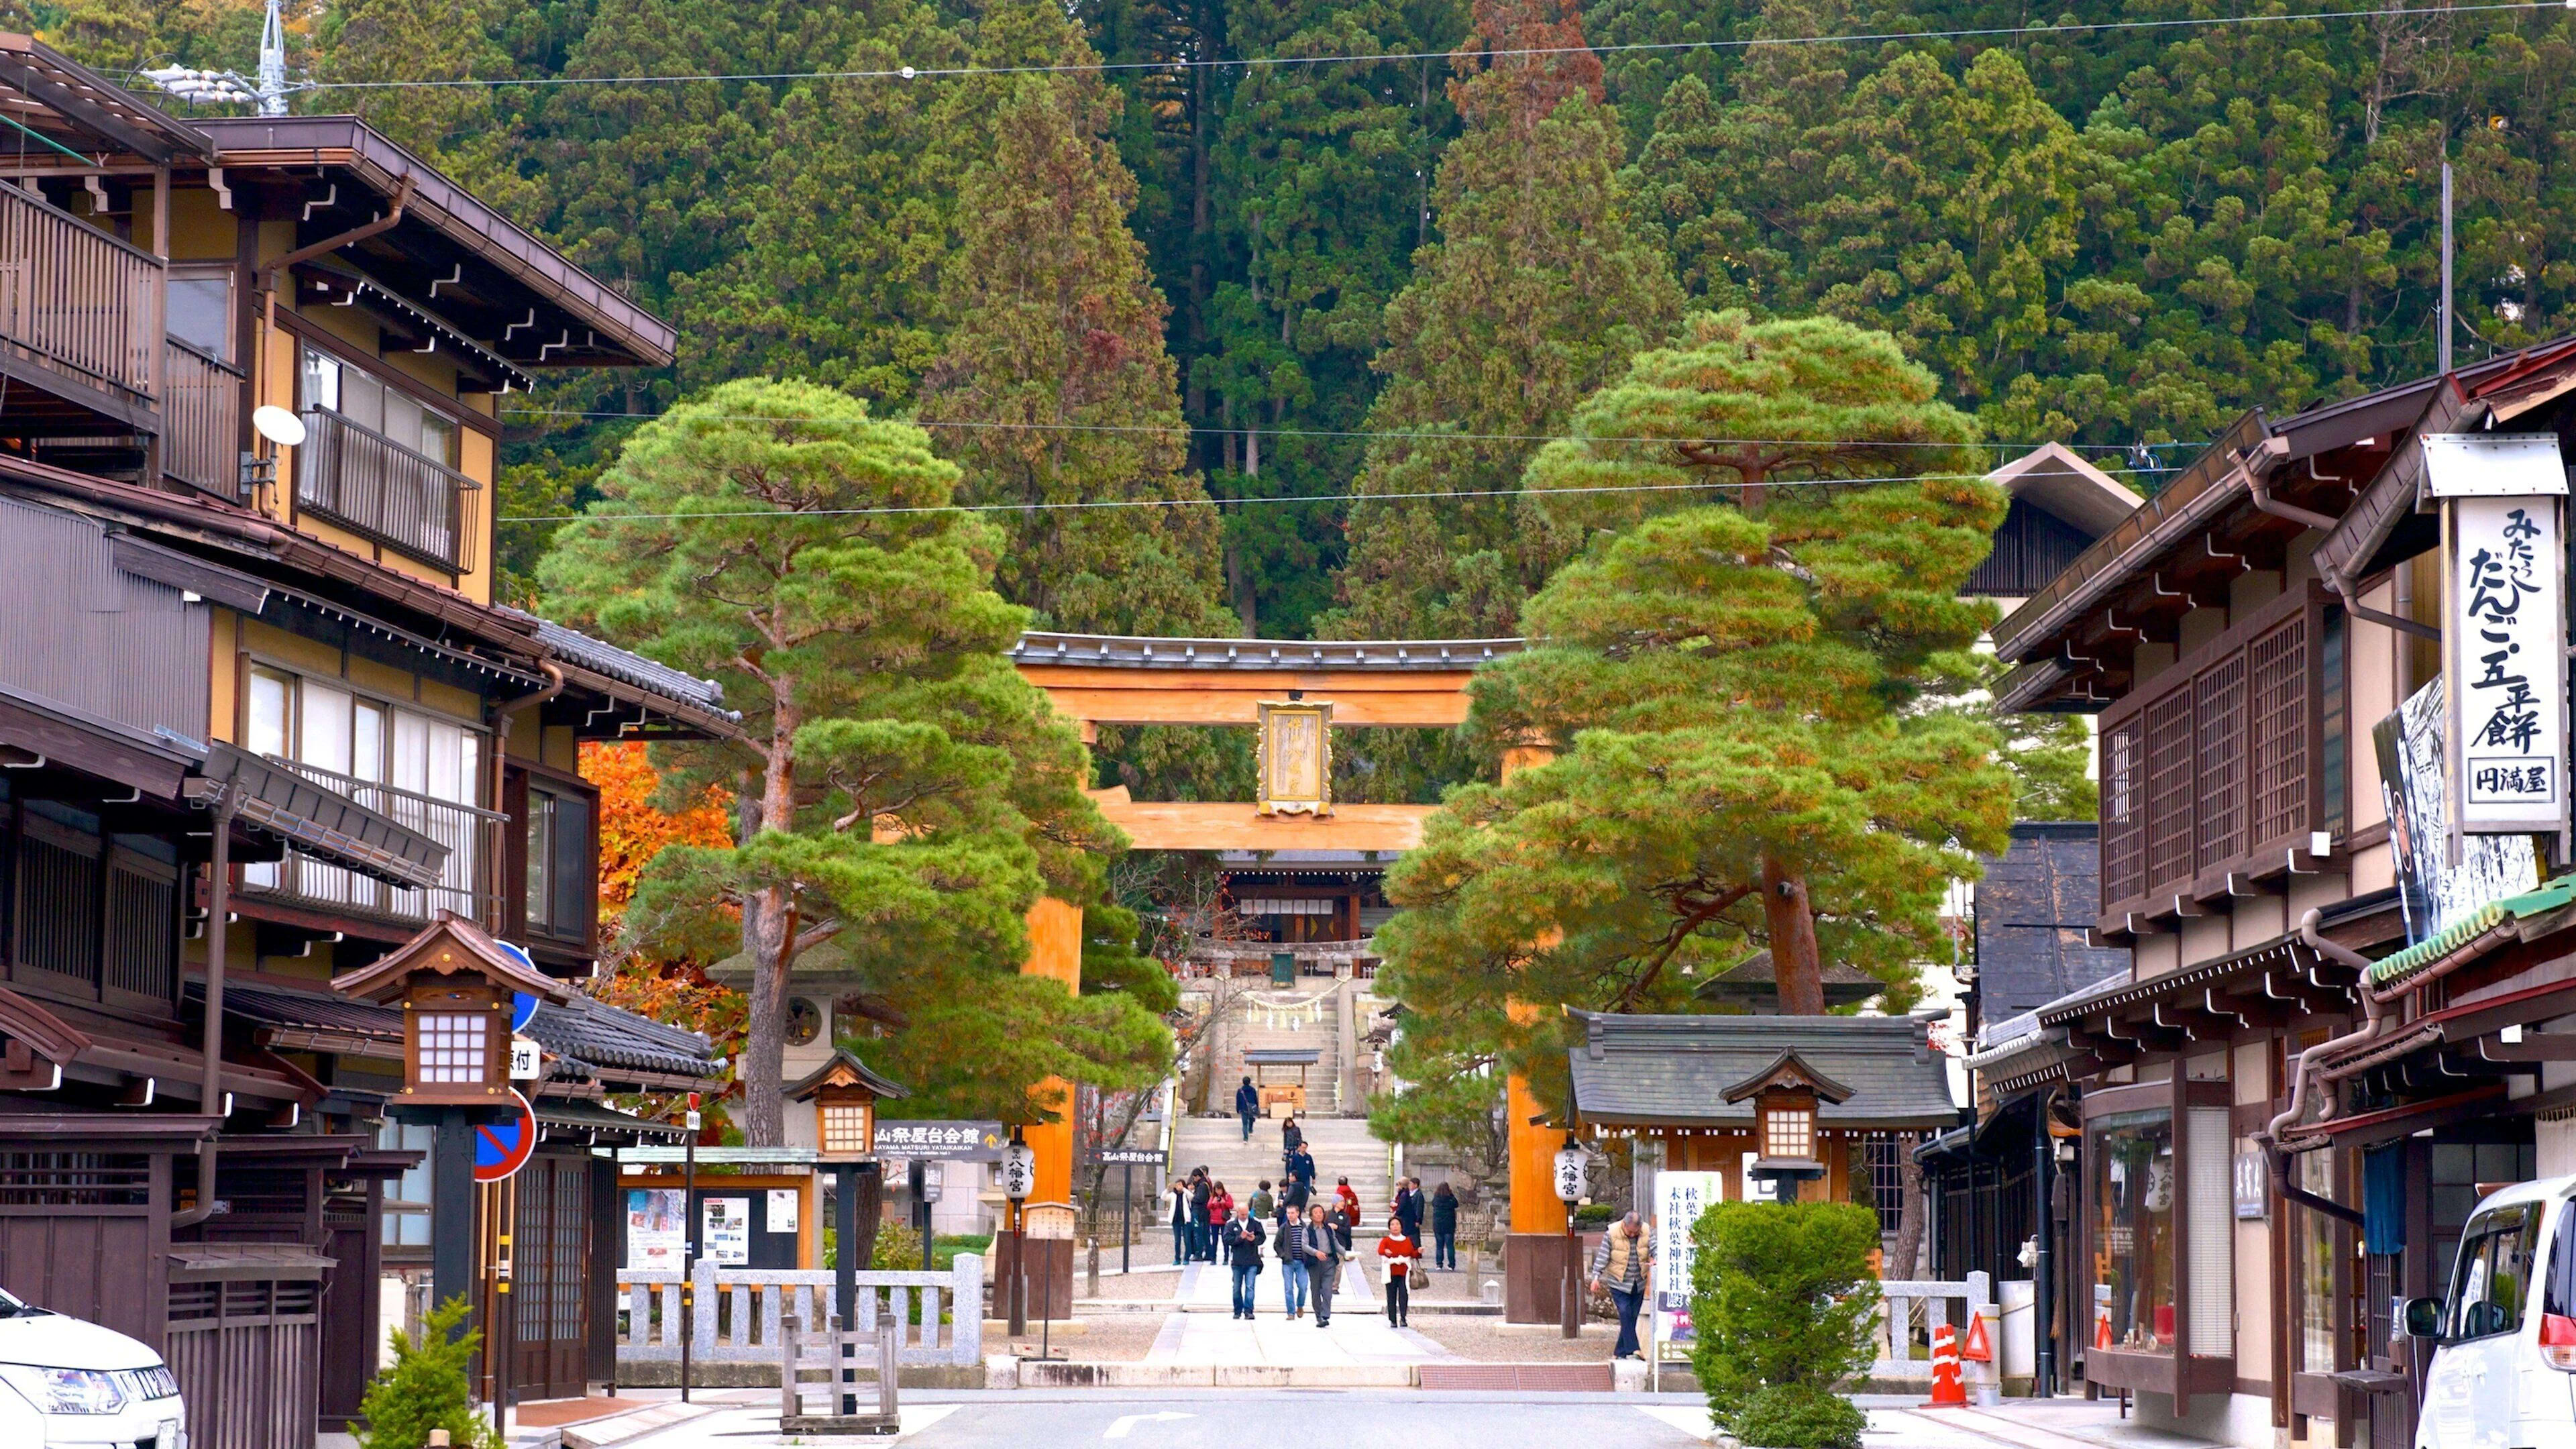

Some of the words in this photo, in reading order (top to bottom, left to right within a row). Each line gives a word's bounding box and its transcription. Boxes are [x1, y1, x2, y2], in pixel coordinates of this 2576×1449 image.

[2476, 766, 2547, 795] 円満屋
[874, 1127, 980, 1144] 山祭屋台会館
